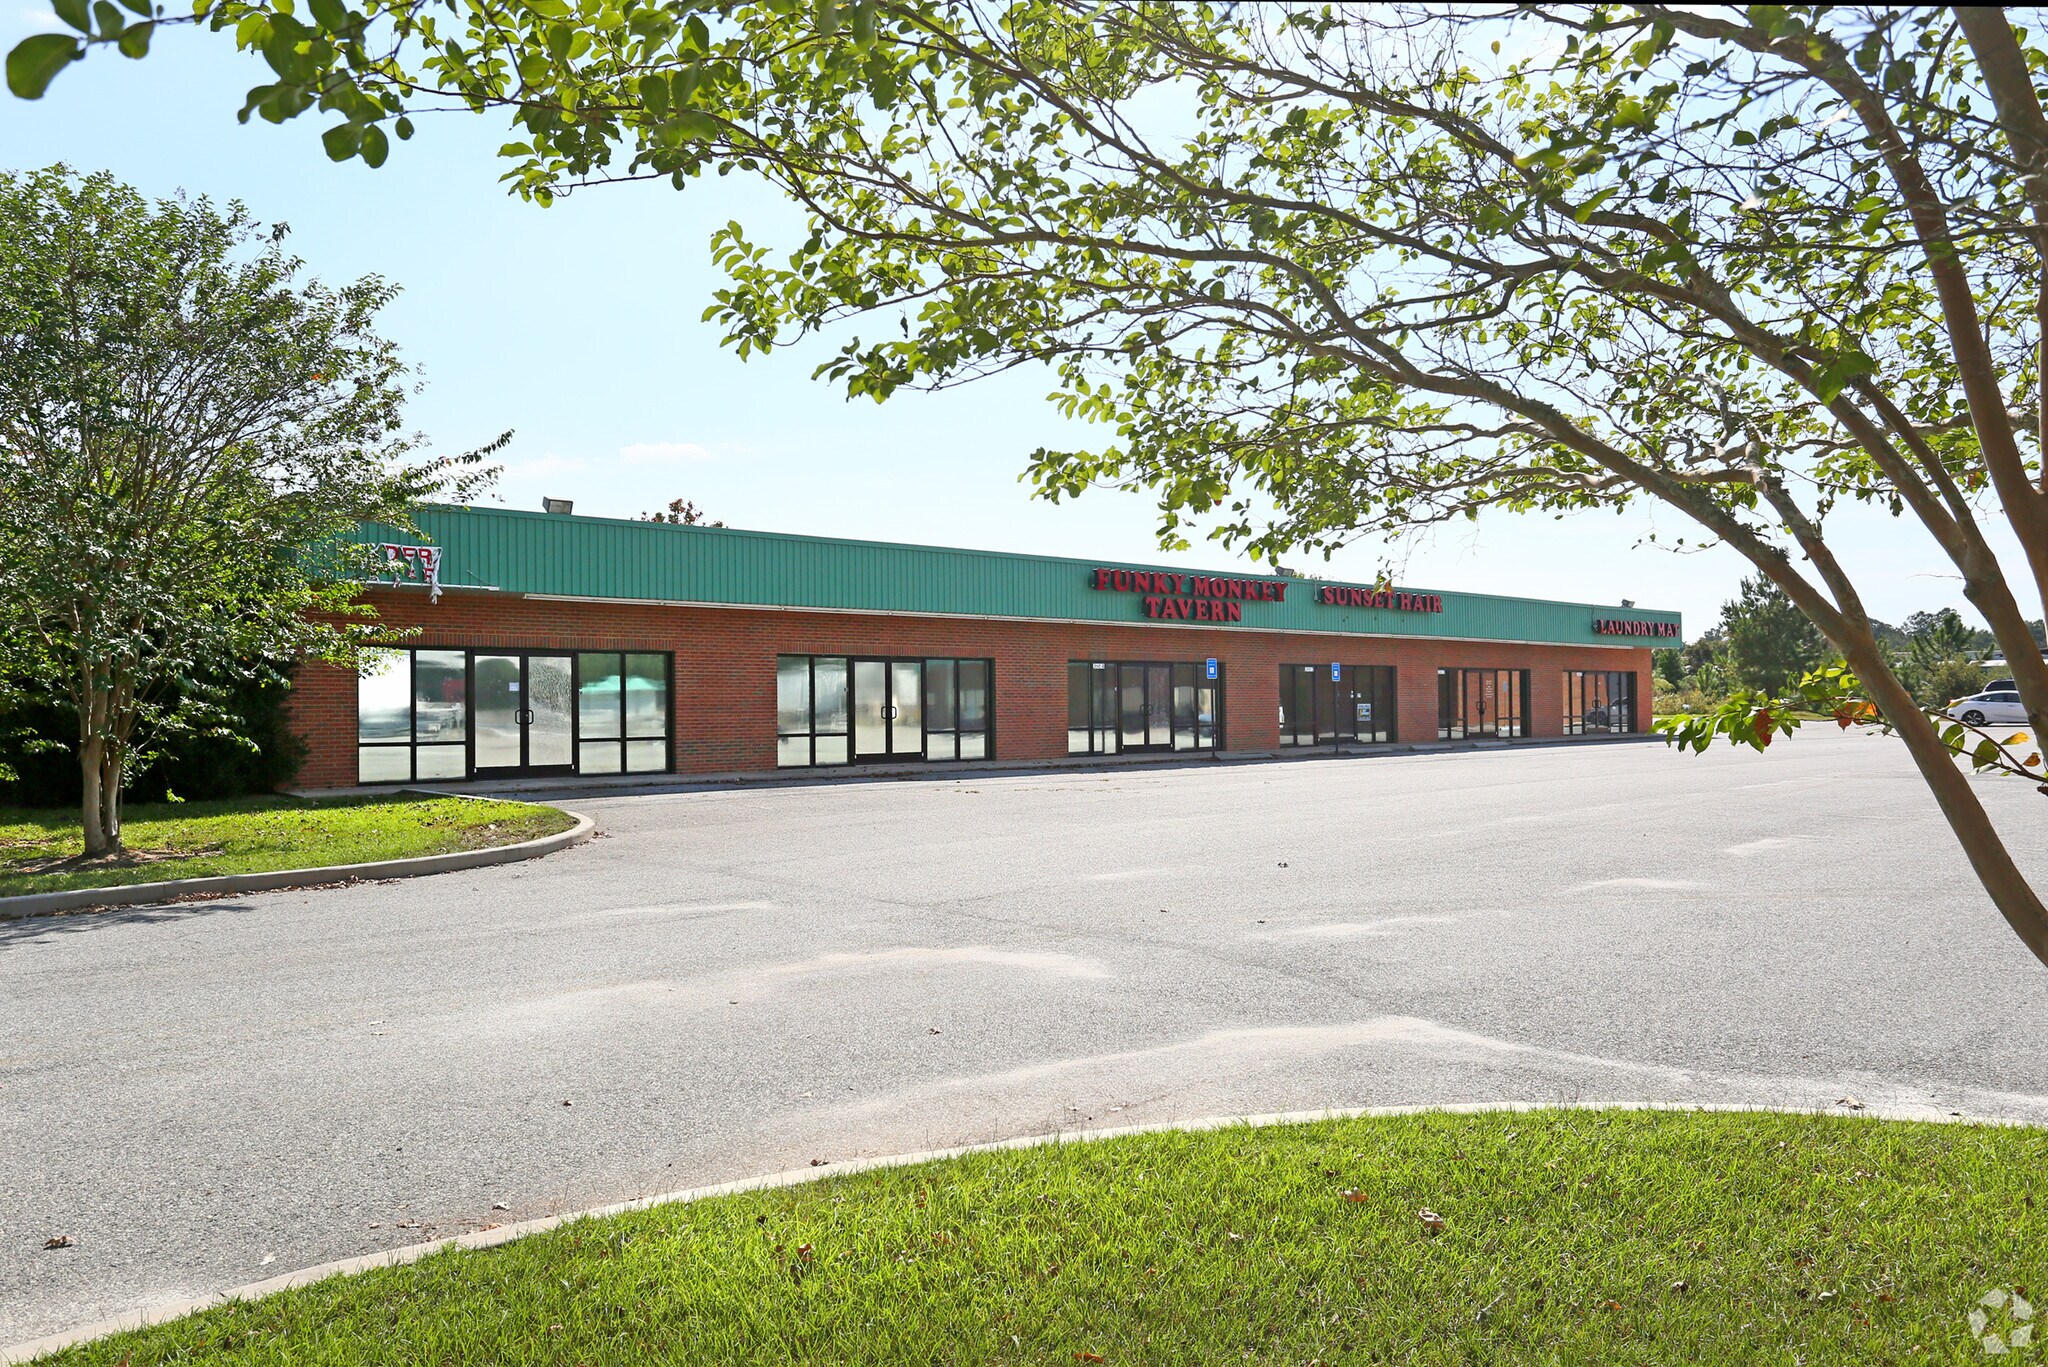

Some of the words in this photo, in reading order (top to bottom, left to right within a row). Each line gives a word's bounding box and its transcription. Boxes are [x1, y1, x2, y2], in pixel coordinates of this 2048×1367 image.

[1093, 567, 1187, 595] FUNKY
[1191, 574, 1288, 603] MONKEY
[1145, 596, 1242, 622] TAVERN
[1323, 586, 1395, 609] SUNSET
[1399, 592, 1443, 613] HAIR
[1599, 619, 1654, 637] LAUNDRY
[1657, 622, 1680, 637] MAT
